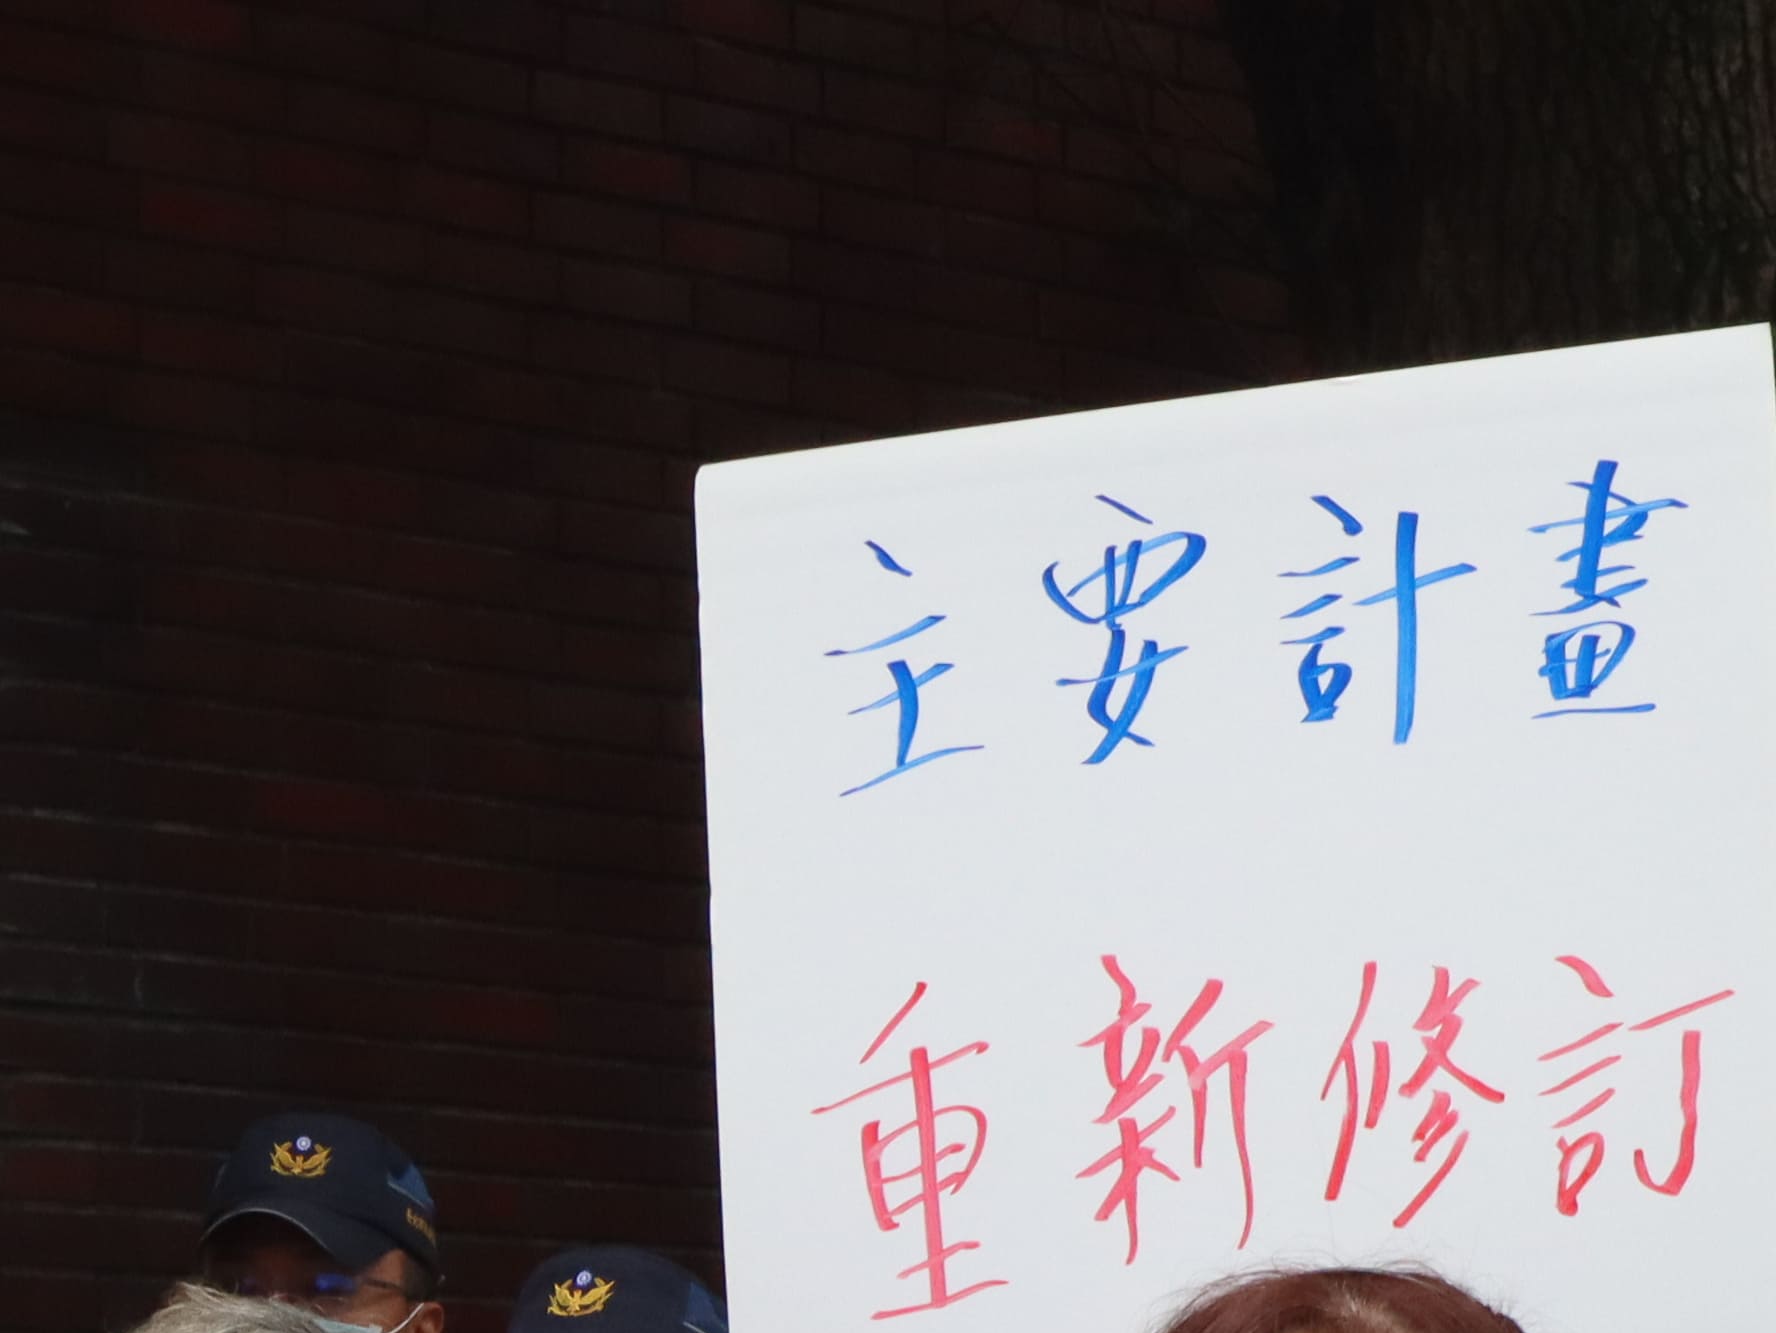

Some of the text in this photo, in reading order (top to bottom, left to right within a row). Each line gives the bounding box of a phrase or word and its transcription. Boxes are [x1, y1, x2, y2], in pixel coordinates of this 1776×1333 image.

[826, 458, 1689, 797] 主要計畫
[810, 953, 1735, 1321] 重新修訂
